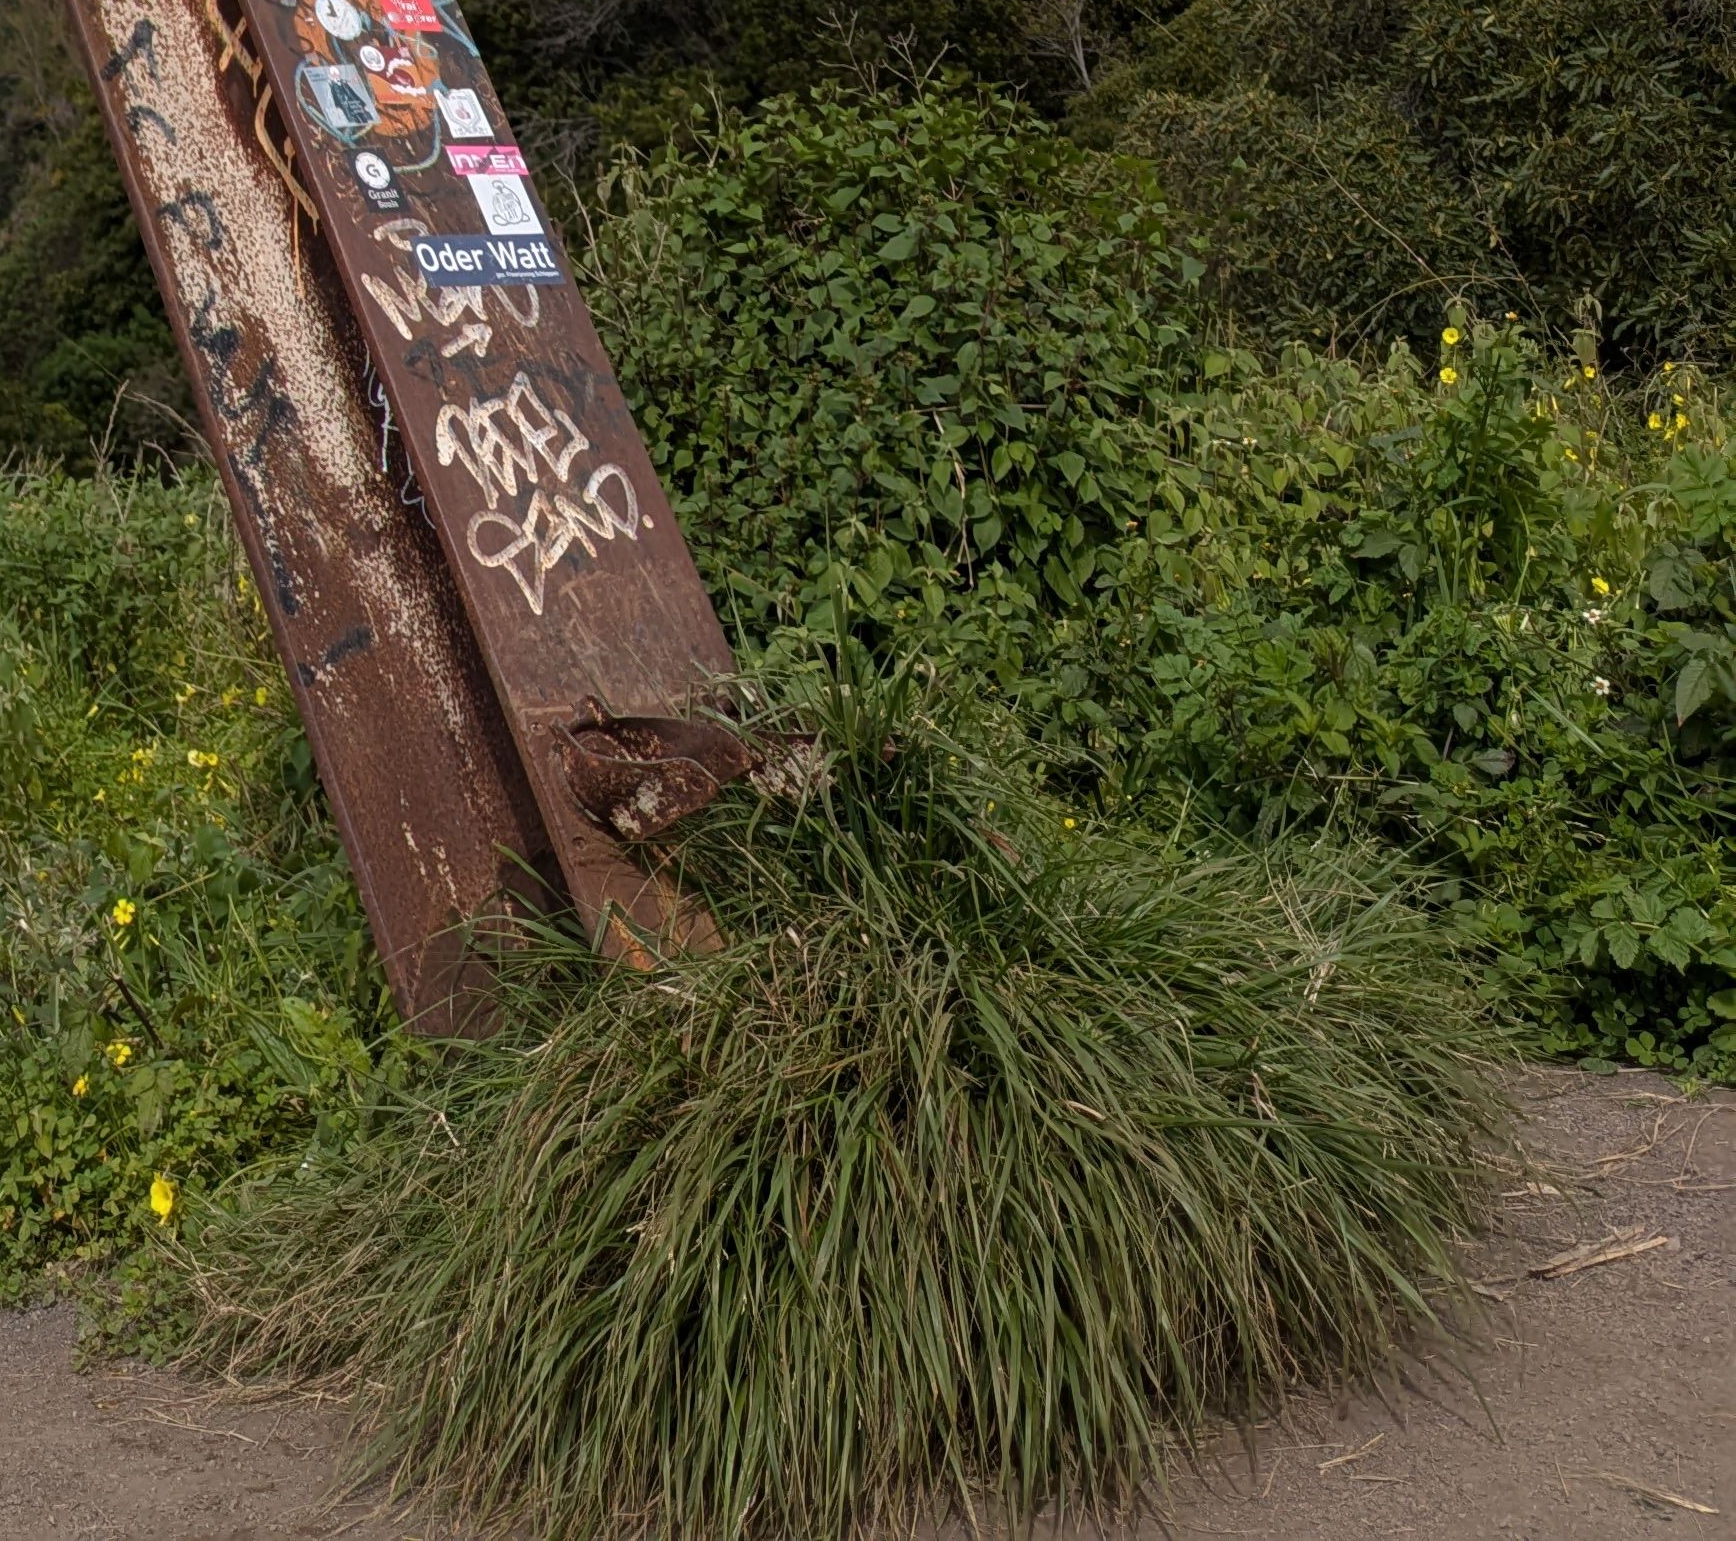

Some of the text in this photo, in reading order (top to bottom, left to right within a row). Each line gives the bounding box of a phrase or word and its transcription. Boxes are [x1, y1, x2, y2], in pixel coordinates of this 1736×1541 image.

[368, 188, 399, 201] Granit
[416, 241, 556, 273] Oder Watt
